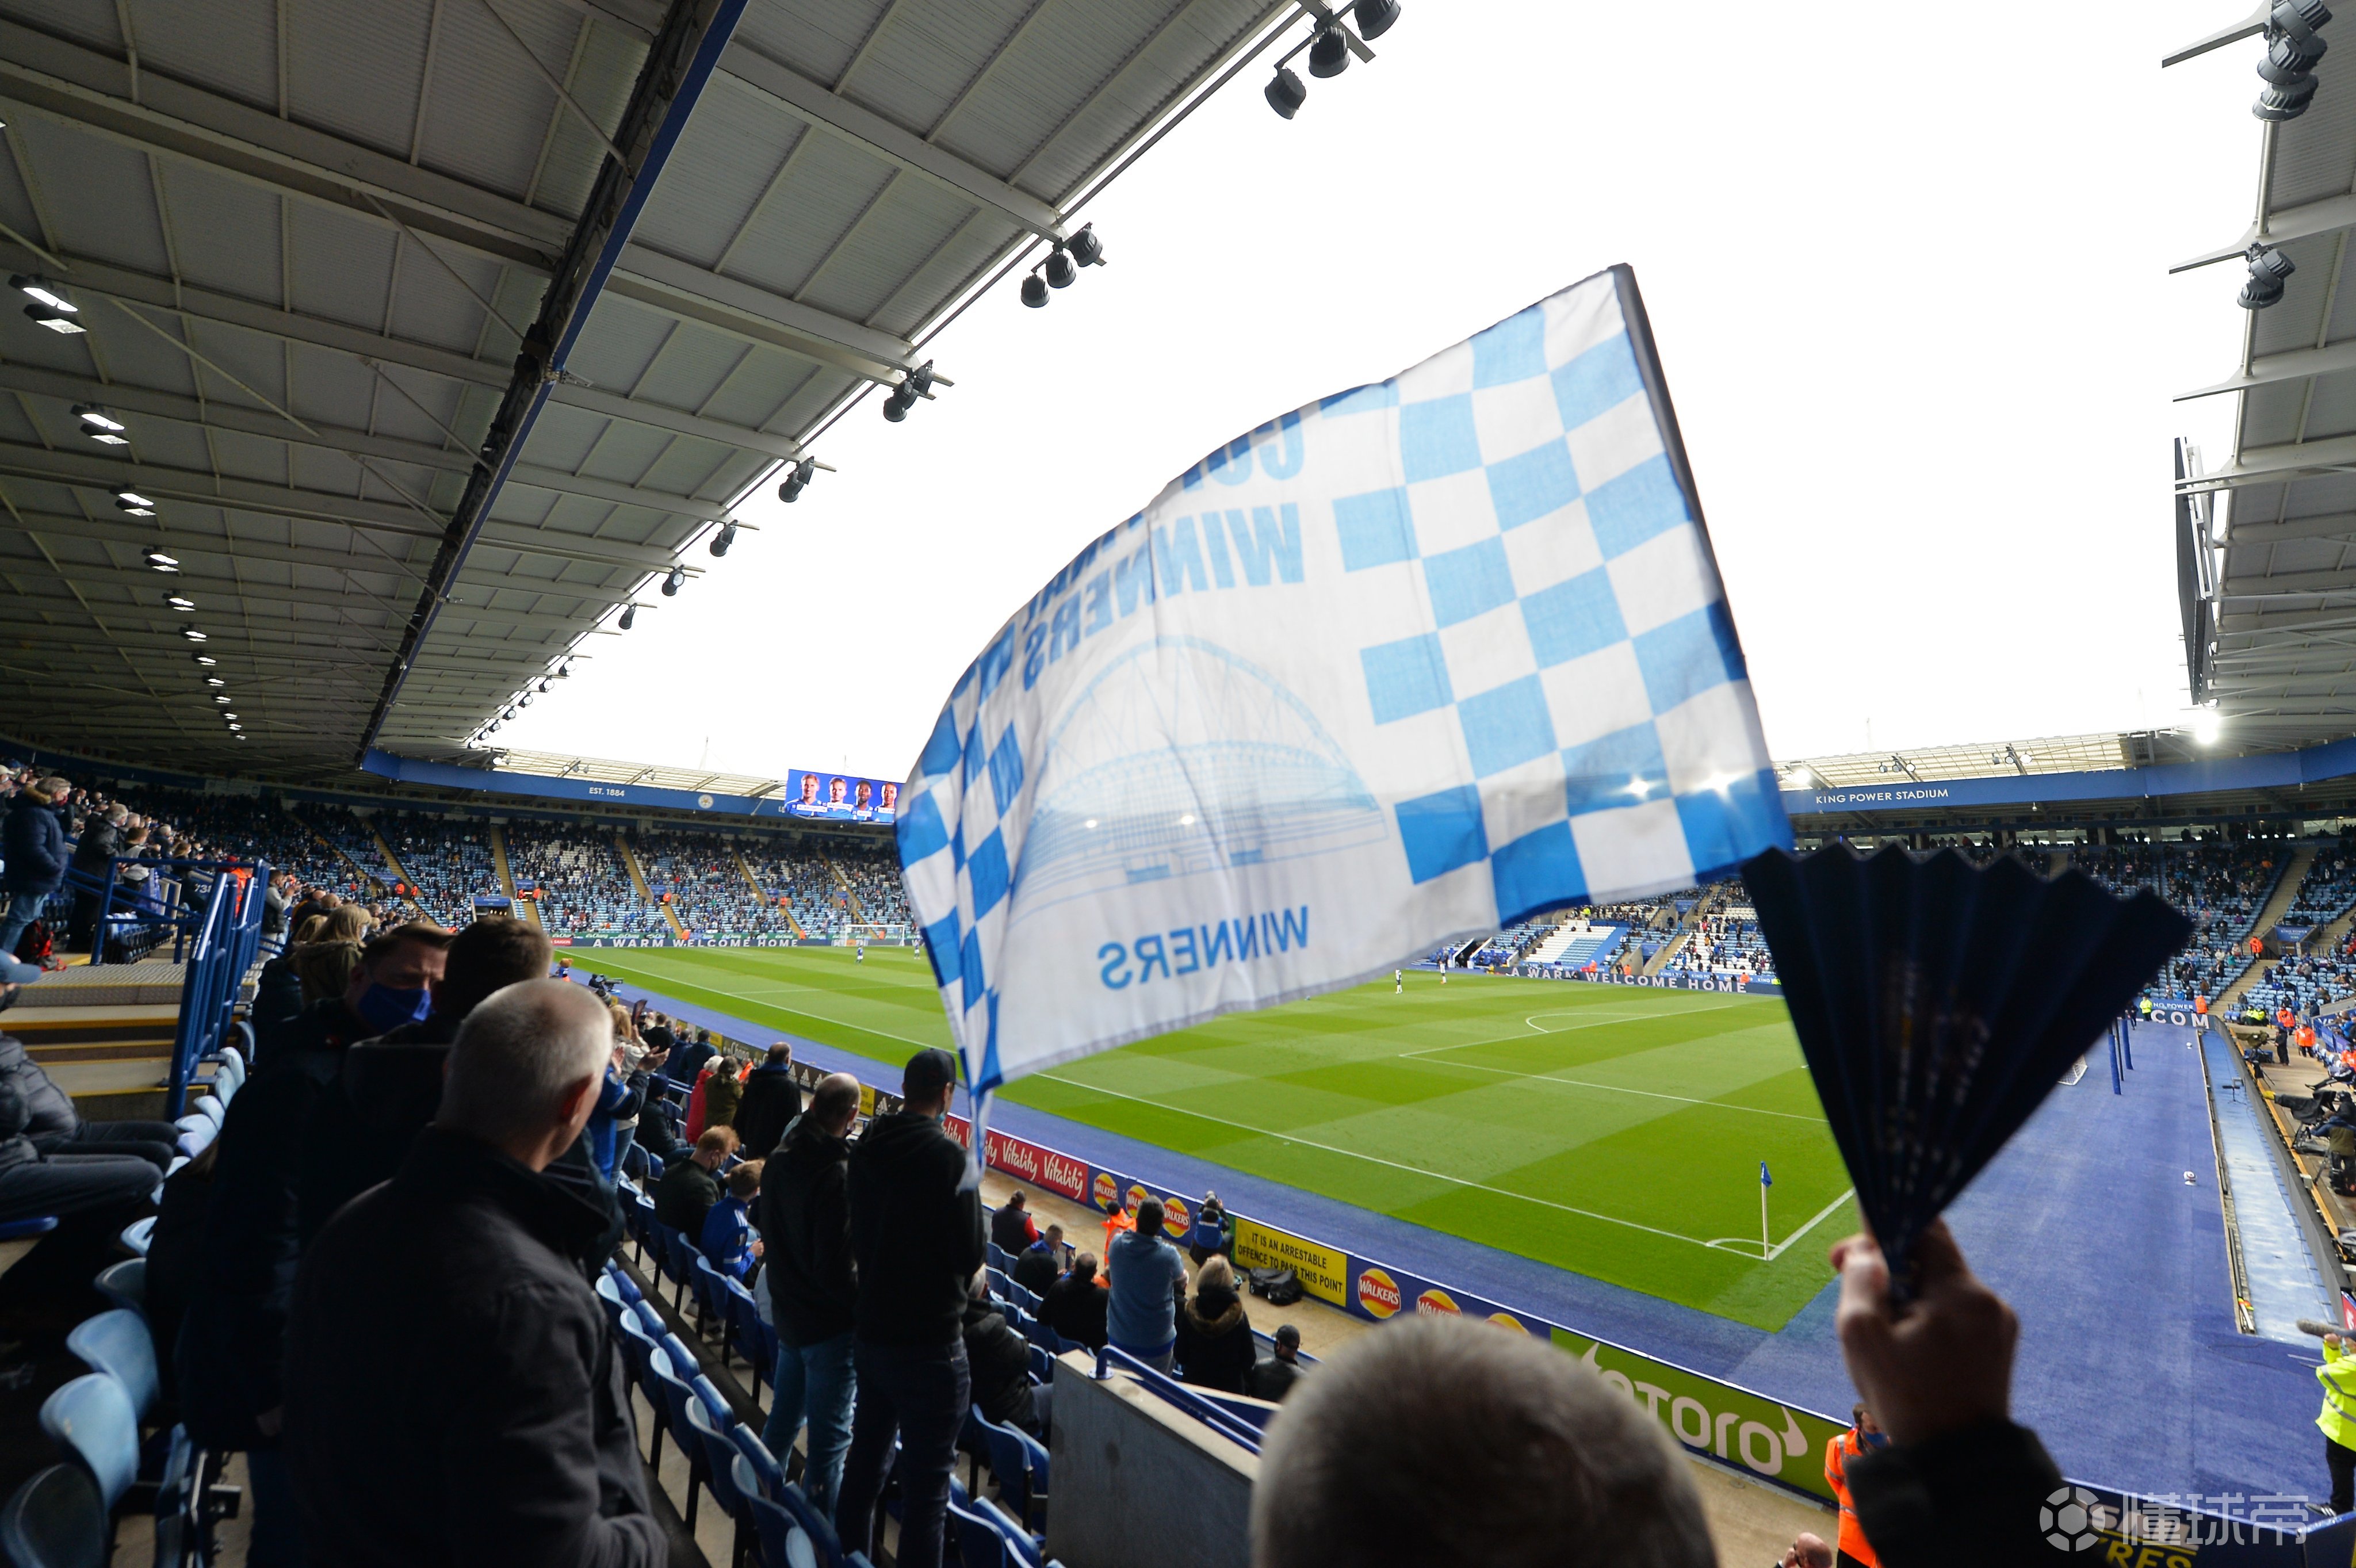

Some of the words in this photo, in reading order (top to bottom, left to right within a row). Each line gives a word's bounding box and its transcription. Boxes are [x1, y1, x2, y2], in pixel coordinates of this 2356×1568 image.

[588, 787, 604, 795] EST.
[606, 789, 625, 797] 1884
[1816, 795, 1846, 804] KING
[1849, 793, 1892, 802] POWER
[1896, 789, 1949, 800] STADIUM
[592, 939, 602, 947] A
[613, 939, 664, 947] WARM
[672, 939, 751, 947] WELCOME
[758, 939, 798, 947] HOME
[1511, 967, 1520, 977] A
[1586, 972, 1678, 988] WELCOME
[1688, 979, 1747, 993] HOME
[1003, 1139, 1038, 1181] Vitality
[1044, 1154, 1083, 1199] Vitality
[1095, 1182, 1116, 1200] WALKERS
[1252, 1233, 1258, 1244] IT
[1260, 1236, 1266, 1247] IS
[1269, 1239, 1278, 1251] AN
[1280, 1243, 1326, 1269] ARRESTABLE
[1238, 1245, 1267, 1264] OFFENCE
[1270, 1257, 1279, 1268] TO
[1301, 1268, 1317, 1283] THIS
[1319, 1276, 1343, 1293] POINT
[1359, 1279, 1399, 1306] WALKERS
